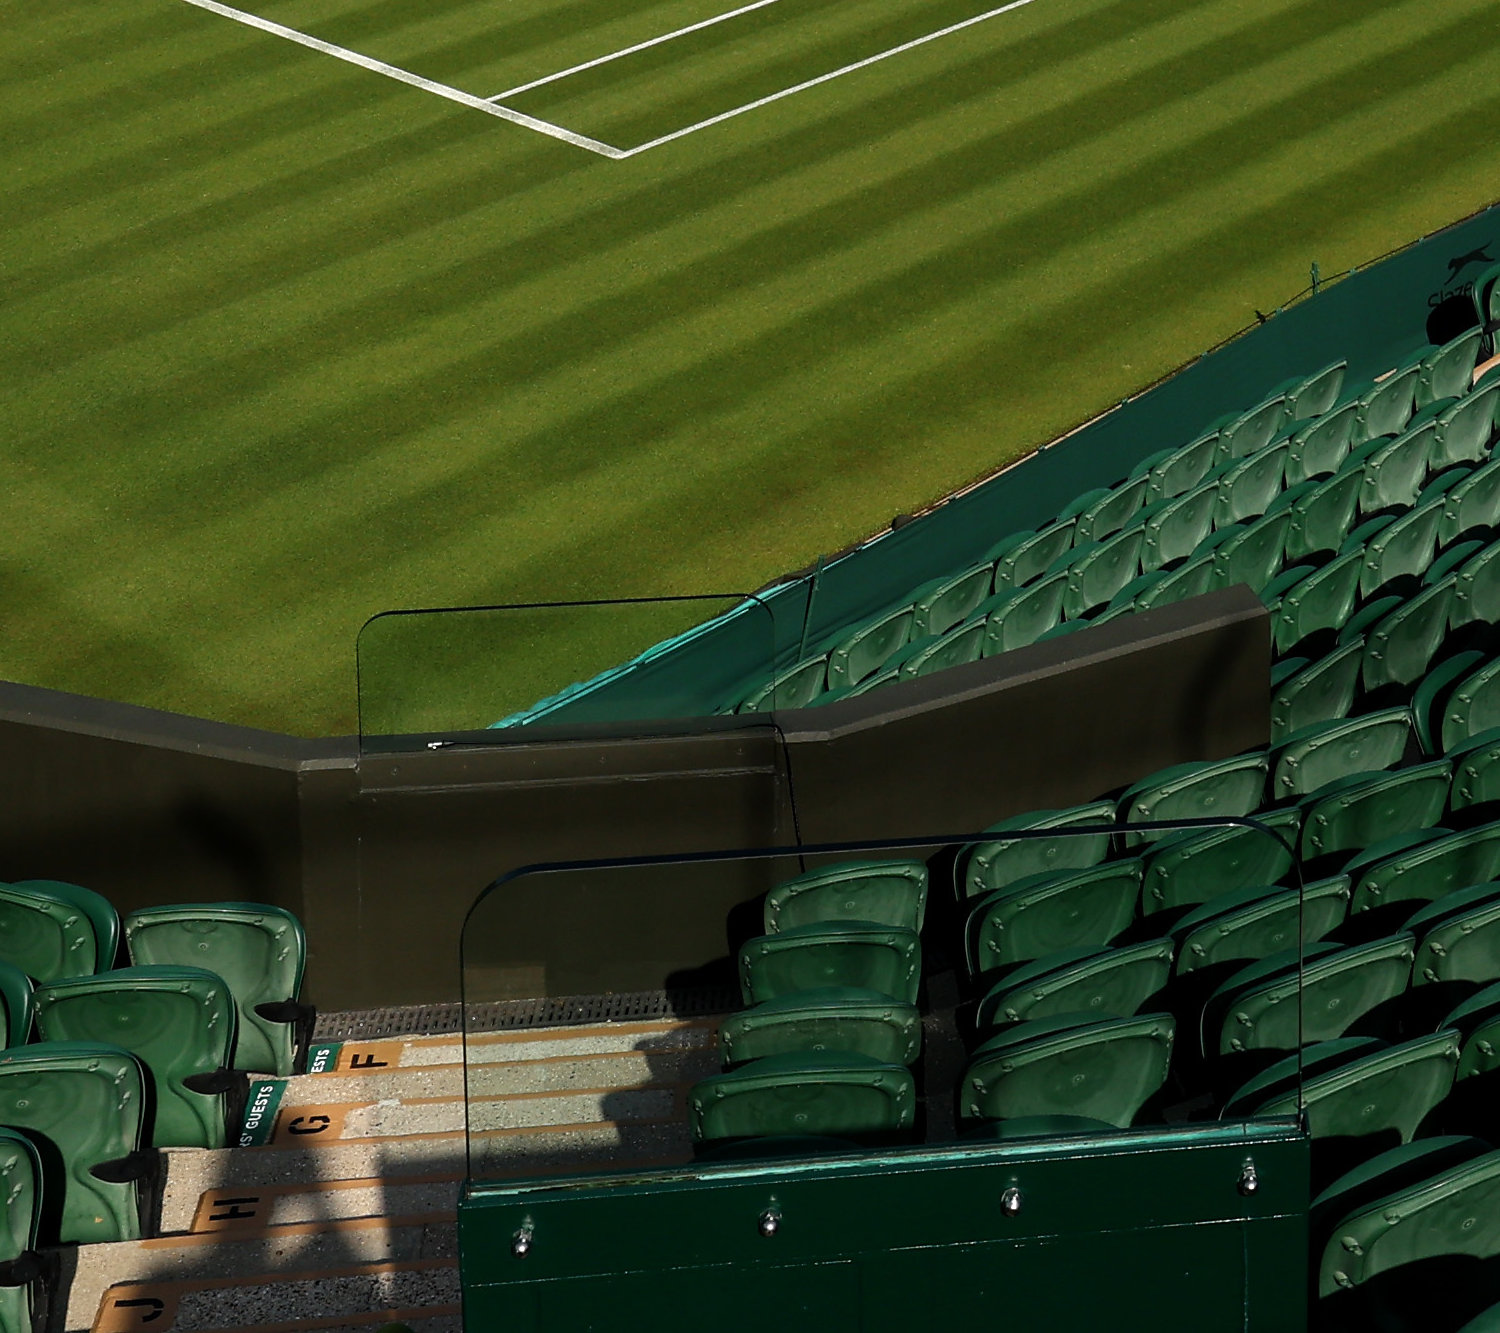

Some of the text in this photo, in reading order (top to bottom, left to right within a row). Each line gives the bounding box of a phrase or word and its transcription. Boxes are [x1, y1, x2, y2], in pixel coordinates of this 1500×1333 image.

[311, 1049, 330, 1074] ESTS
[349, 1054, 388, 1069] F
[246, 1086, 274, 1129] GUESTS
[288, 1115, 330, 1135] G
[209, 1197, 259, 1221] H
[114, 1298, 165, 1323] J
